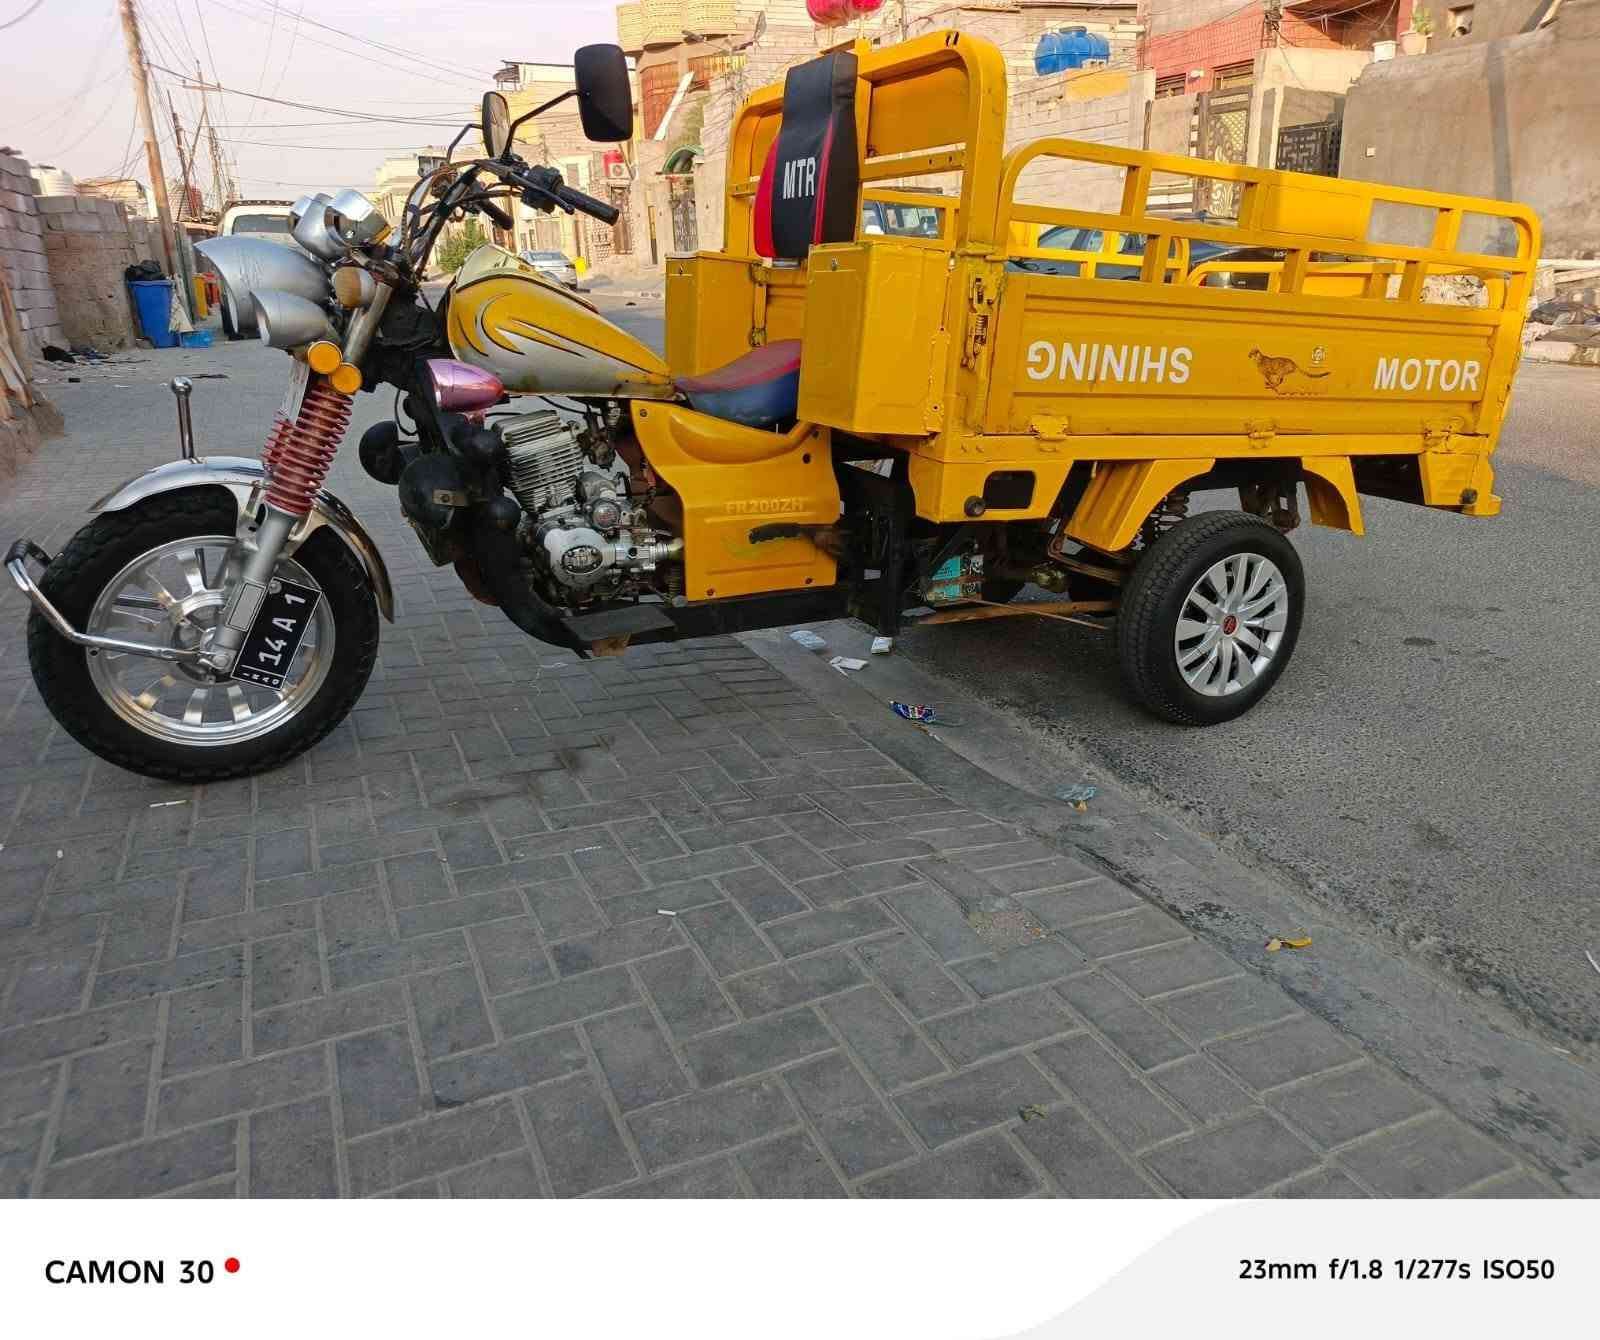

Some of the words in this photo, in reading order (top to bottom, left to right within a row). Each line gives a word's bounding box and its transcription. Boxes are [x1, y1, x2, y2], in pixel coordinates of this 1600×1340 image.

[783, 157, 816, 199] MTR
[1374, 357, 1481, 392] MOTOR
[284, 593, 306, 605] 1
[272, 617, 297, 633] A
[258, 637, 288, 667] 14
